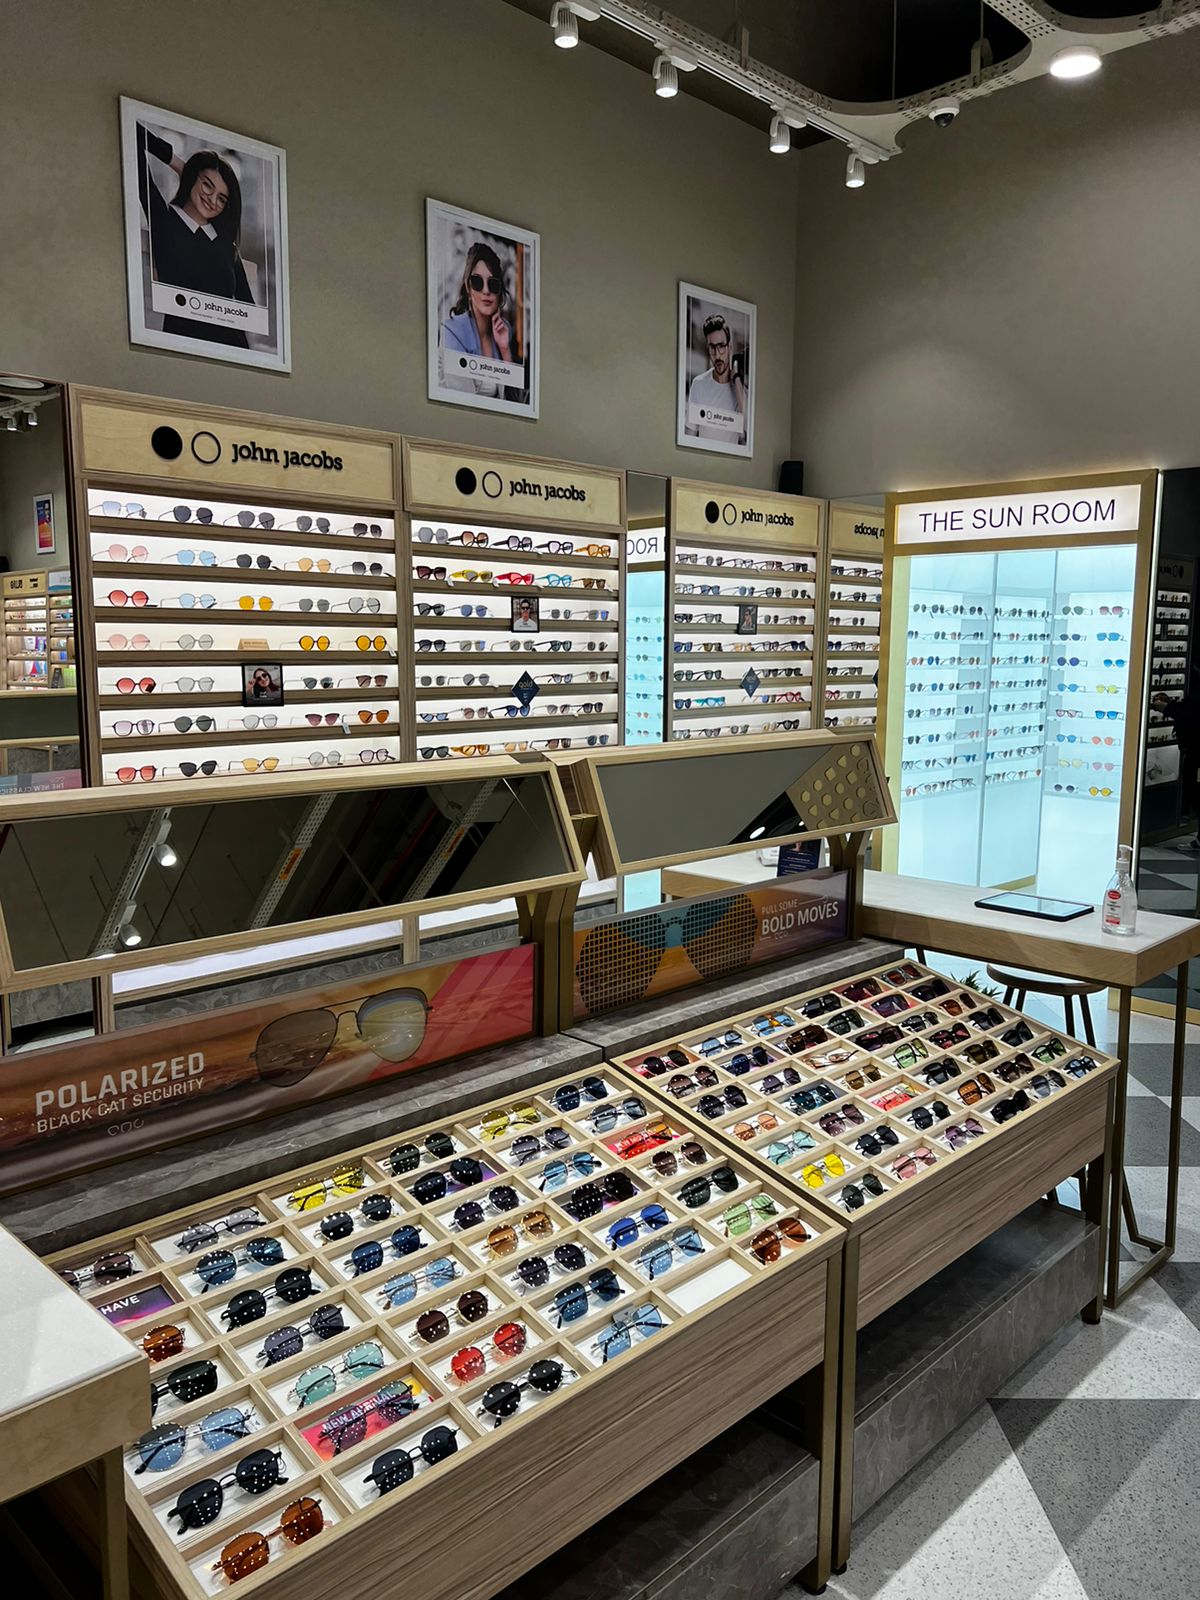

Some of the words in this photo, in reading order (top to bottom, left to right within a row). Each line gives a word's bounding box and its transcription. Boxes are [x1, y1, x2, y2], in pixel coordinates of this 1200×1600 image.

[204, 302, 223, 312] john
[224, 307, 248, 318] jacobs
[480, 363, 493, 372] john
[493, 366, 511, 375] jacobs
[232, 441, 279, 463] john
[283, 450, 343, 471] jacobs
[509, 478, 542, 496] john
[544, 485, 586, 502] jacobs
[741, 508, 763, 523] john
[764, 512, 794, 526] jacobs
[919, 510, 964, 533] THE
[972, 506, 1023, 530] SUN
[1032, 499, 1115, 526] ROOM
[761, 904, 778, 915] PULL
[779, 898, 798, 912] SOME
[762, 912, 794, 935] BOLD
[797, 901, 838, 926] MOVES
[35, 1052, 205, 1117] POLARIZED
[37, 1106, 92, 1134] BLACK
[98, 1097, 128, 1117] CAT
[132, 1077, 204, 1107] SECURITY
[100, 1295, 140, 1315] HAVE
[322, 1413, 348, 1431] NEW
